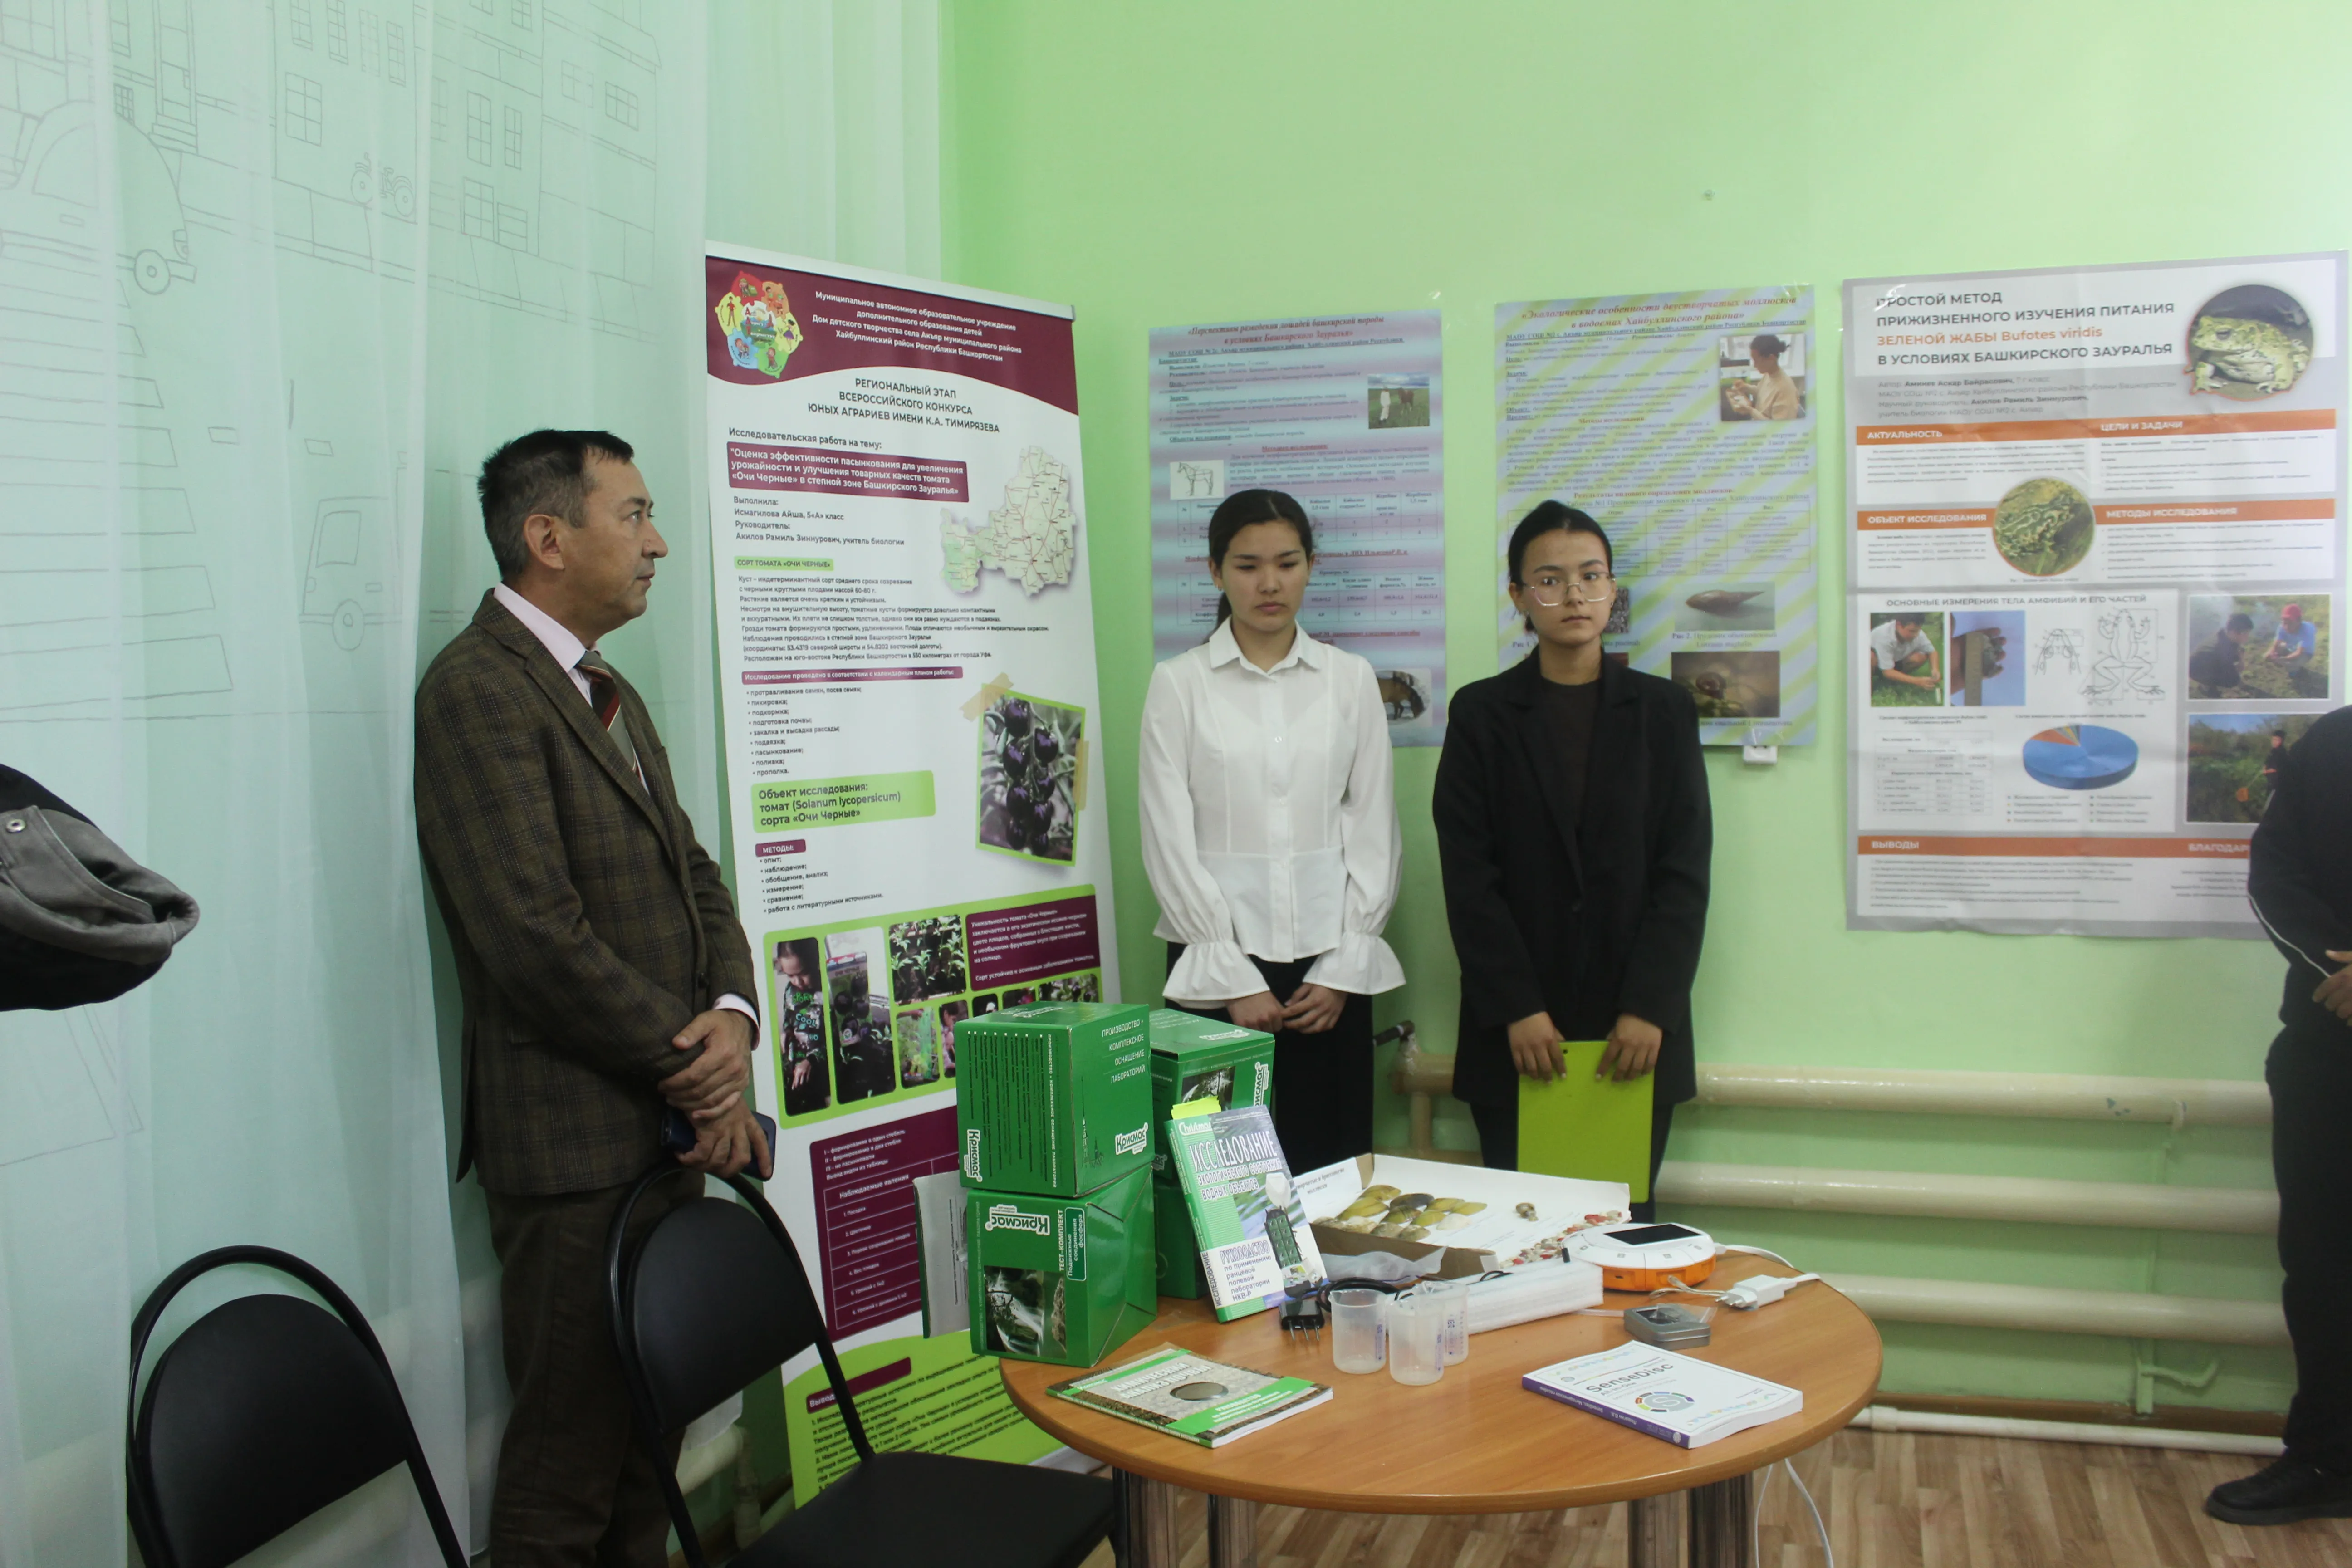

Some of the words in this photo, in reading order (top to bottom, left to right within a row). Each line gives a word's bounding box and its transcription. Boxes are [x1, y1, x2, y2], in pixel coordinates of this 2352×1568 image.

[1950, 292, 2002, 304] МЕТОД
[815, 291, 874, 307] Муниципальное
[876, 302, 917, 314] автономное
[918, 308, 975, 324] образовательное
[976, 319, 1016, 330] учреждение
[1877, 311, 2010, 326] ПРИЖИЗНЕННОГО
[2015, 307, 2095, 320] ИЗУЧЕНИЯ
[2100, 303, 2174, 316] ПИТАНИЯ
[812, 314, 828, 323] Дом
[829, 318, 862, 328] детского
[863, 323, 902, 334] творчества
[921, 331, 942, 342] Акъяр
[943, 336, 997, 349] муниципального
[998, 344, 1021, 353] района
[856, 311, 918, 326] дополнительного
[919, 319, 962, 332] образования
[963, 328, 982, 336] детей
[836, 330, 892, 344] Хайбуллинский
[894, 339, 914, 348] район
[916, 342, 957, 354] Республики
[958, 348, 1002, 361] Башкортостан
[1877, 332, 1945, 346] ЗЕЛЕНОЙ
[1950, 332, 1996, 343] ЖАБЫ
[2001, 330, 2056, 341] Bufotes
[2059, 326, 2102, 338] viridis
[1878, 355, 1886, 365] В
[1891, 353, 1969, 364] УСЛОВИЯХ
[1975, 347, 2088, 362] БАШКИРСКОГО
[2093, 343, 2172, 357] ЗАУРАЛЬЯ
[855, 378, 931, 395] РЕГИОНАЛЬНЫЙ
[933, 388, 956, 398] ЭТАП
[839, 391, 923, 409] ВСЕРОССИЙСКОГО
[926, 402, 972, 415] КОНКУРСА
[808, 402, 838, 415] ЮНЫХ
[841, 407, 890, 420] АГРАРИЕВ
[892, 412, 923, 424] ИМЕНИ
[926, 416, 943, 426] К.А.
[945, 418, 999, 432] ТИМИРЯЗЕВА
[2100, 423, 2129, 431] ЦЕЛИ
[2141, 421, 2182, 430] ЗАДАЧИ
[729, 427, 817, 442] Исследовательская
[819, 435, 846, 445] работа
[860, 441, 882, 450] тему:
[1867, 430, 1945, 439] АКТУАЛЬНОСТЬ
[731, 461, 792, 471] урожайности
[802, 466, 849, 475] улучшения
[850, 470, 890, 479] товарных
[892, 473, 921, 481] качеств
[770, 451, 839, 464] эффективности
[841, 458, 900, 468] пасынкования
[916, 464, 963, 473] увеличения
[732, 471, 754, 480] «Очи
[756, 473, 797, 483] Черные»
[807, 477, 841, 486] степной
[863, 480, 917, 491] Башкирского
[918, 484, 958, 495] Зауралья»
[734, 508, 779, 517] Исмагилова
[781, 510, 805, 519] Айша,
[1907, 514, 1986, 523] ИССЛЕДОВАНИЯ
[2106, 509, 2151, 518] МЕТОДЫ
[2152, 507, 2237, 516] ИССЛЕДОВАНИЯ
[735, 520, 790, 529] Руководитель:
[796, 534, 841, 544] Зиннурович,
[758, 789, 797, 799] Объект
[799, 784, 867, 796] исследования:
[759, 803, 789, 812] томат
[792, 799, 836, 811] (Solanum
[838, 791, 900, 807] lycopersicum)
[760, 816, 789, 827] сорта
[793, 813, 818, 822] «Очи
[820, 809, 860, 821] Черные»
[763, 845, 794, 853] МЕТОДЫ:
[1871, 841, 1919, 849] ВЫВОДЫ
[1102, 1019, 1140, 1037] ПРОИЗВОДСТВО
[1109, 1034, 1144, 1052] КОМПЛЕКСНОЕ
[1115, 1049, 1145, 1066] ОСНАЩЕНИЕ
[1111, 1064, 1146, 1083] ЛАБОРАТОРИЙ
[1117, 1130, 1145, 1152] Крисмас
[968, 1131, 980, 1176] Крисмас
[1189, 1131, 1277, 1172] ИССЛЕДОВАНИЕ
[1197, 1165, 1250, 1186] ЭКОЛОГИЧЕСКОГО
[1250, 1158, 1283, 1176] СОСТОЯНИЯ
[1202, 1183, 1227, 1200] ВОДНЫХ
[1228, 1178, 1259, 1195] ОБЪЕКТОВ
[991, 1216, 1048, 1233] Крисмас
[1220, 1240, 1270, 1264] РУКОВОДСТВО
[1234, 1255, 1271, 1269] применению
[1202, 1252, 1222, 1307] ИССЛЕДОВАНИЕ
[1226, 1267, 1255, 1280] ранцевой
[1229, 1275, 1254, 1287] полевой
[1231, 1279, 1270, 1294] лаборатории
[1233, 1291, 1252, 1302] НКВ-Р
[1586, 1363, 1673, 1393] SenseDisc
